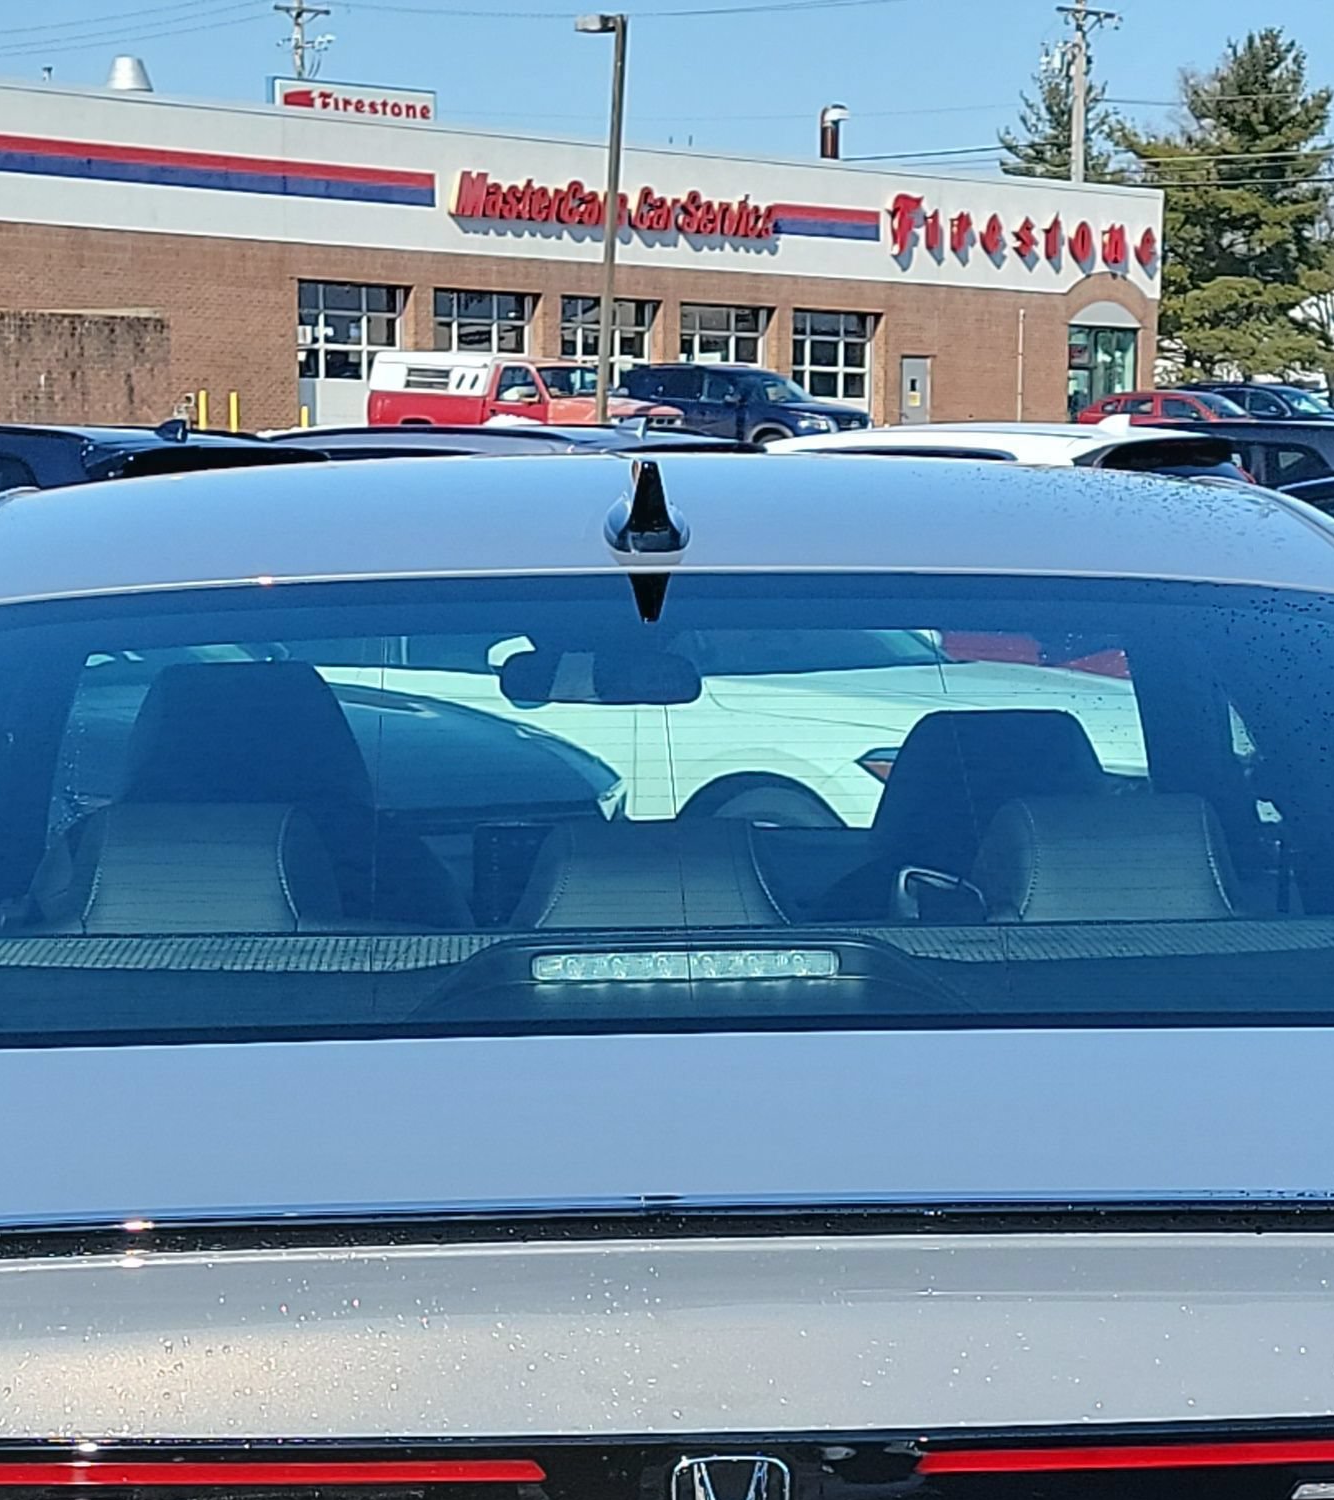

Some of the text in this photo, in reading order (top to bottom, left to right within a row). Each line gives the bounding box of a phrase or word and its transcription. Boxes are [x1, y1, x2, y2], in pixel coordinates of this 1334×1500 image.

[318, 90, 432, 120] Firestone
[452, 170, 630, 226] MasterCae
[885, 193, 1158, 267] Firestone
